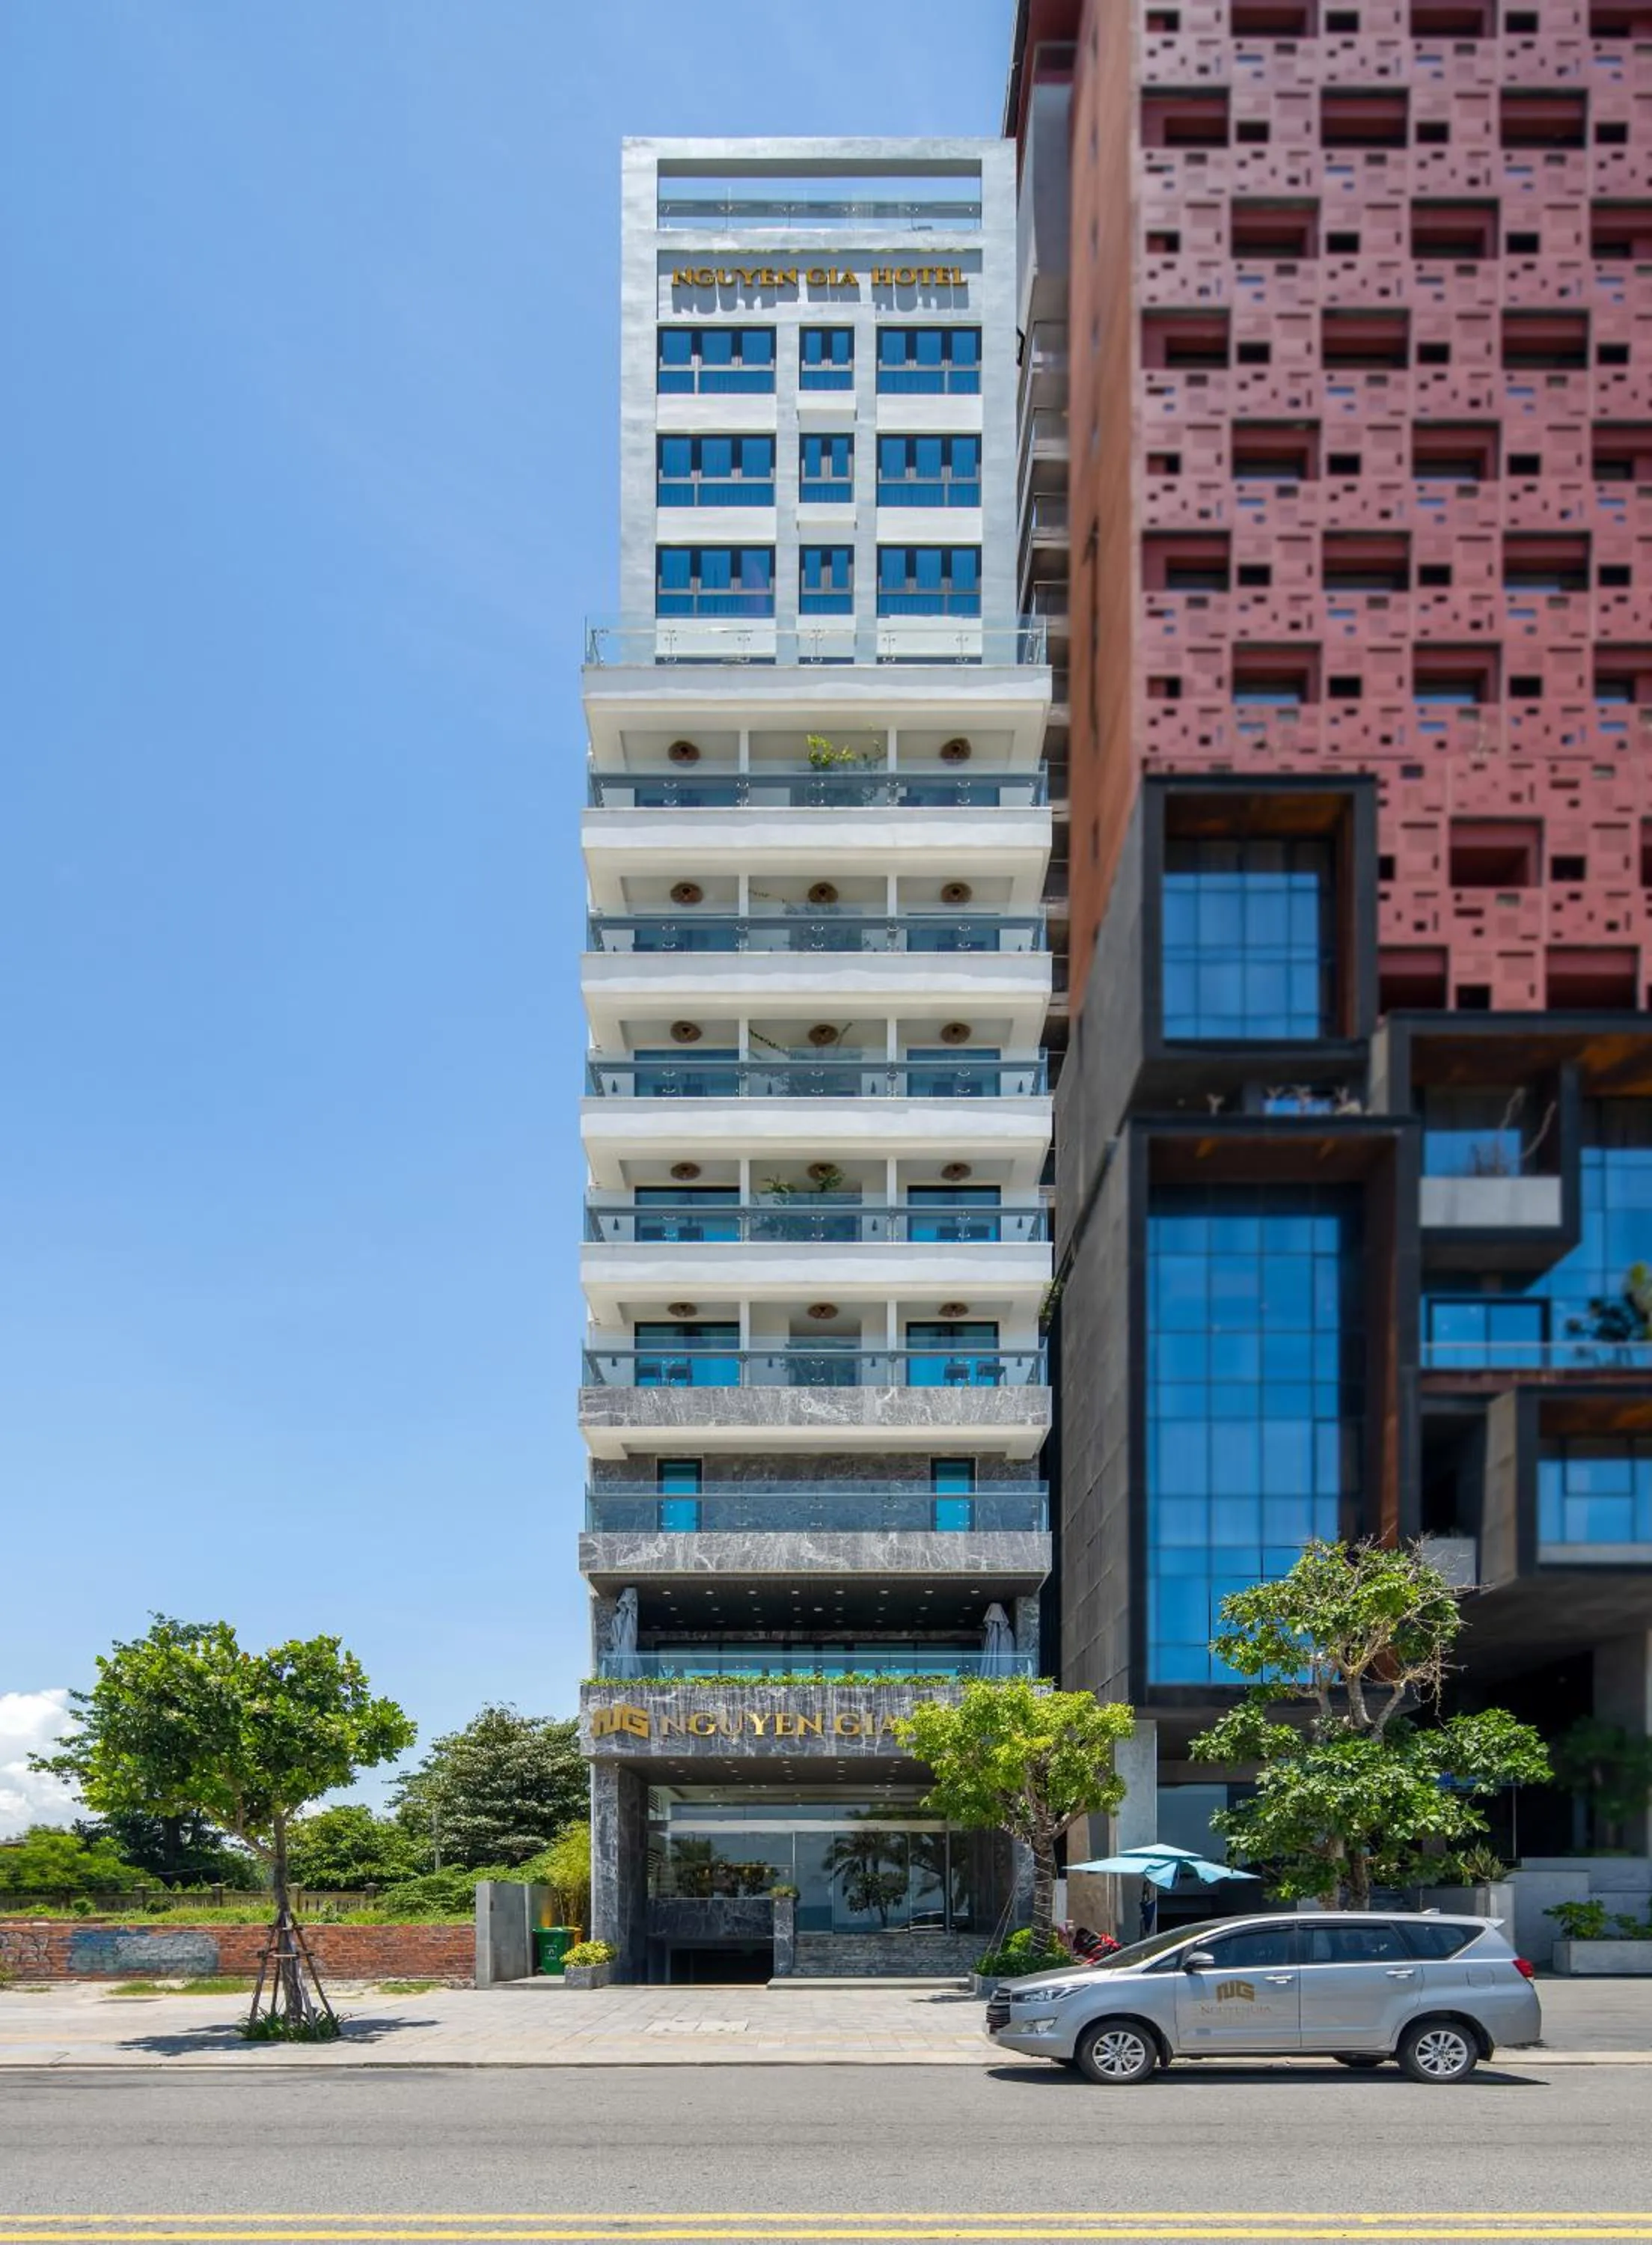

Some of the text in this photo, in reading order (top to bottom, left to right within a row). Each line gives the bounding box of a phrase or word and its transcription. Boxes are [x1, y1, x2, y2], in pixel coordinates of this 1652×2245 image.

[671, 266, 967, 287] NGUYEN GIA HOTEL
[660, 1712, 822, 1736] NGUYEN
